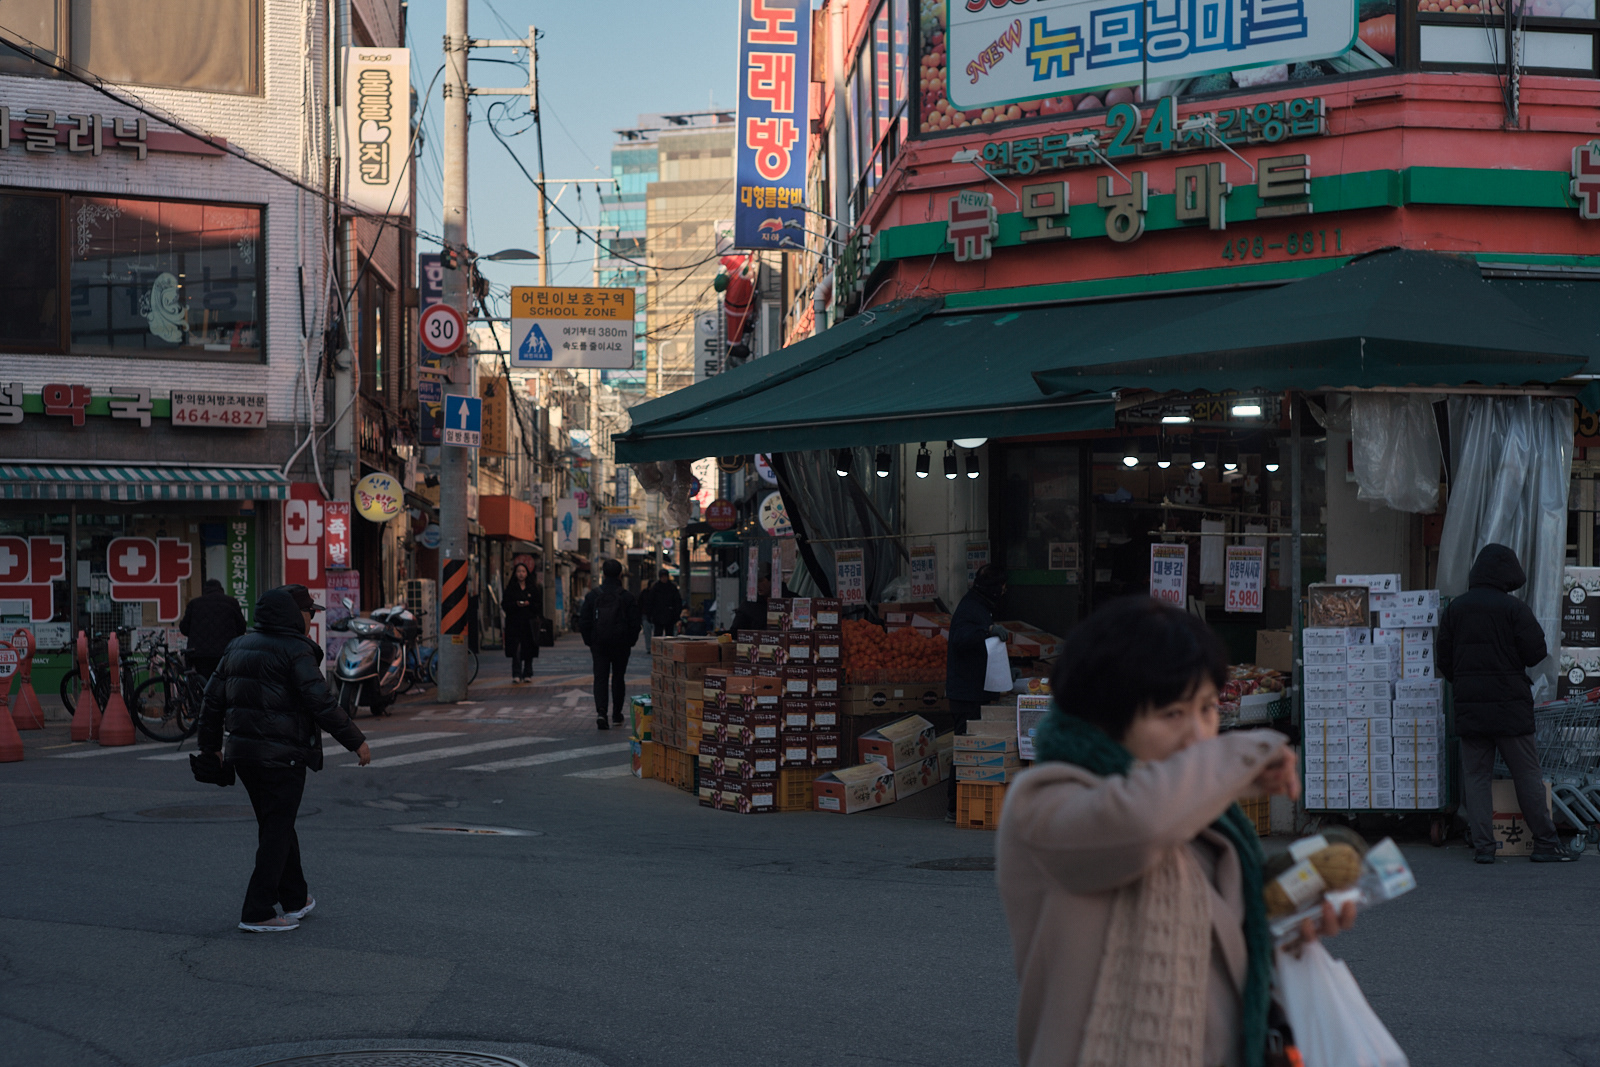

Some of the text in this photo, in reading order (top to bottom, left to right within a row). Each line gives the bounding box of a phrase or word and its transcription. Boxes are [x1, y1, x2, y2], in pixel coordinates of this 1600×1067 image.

[965, 19, 1022, 84] NEW
[747, 0, 800, 181] 노래방
[360, 142, 390, 185] 치킨
[741, 187, 802, 209] 대형룸완비
[961, 193, 985, 207] NEW
[761, 233, 779, 242] 지하
[1222, 229, 1344, 261] 498-8811
[521, 291, 625, 306] 어린이보호구역
[529, 306, 617, 316] SCHOOL ZONE
[431, 319, 454, 339] 30
[562, 327, 628, 337] 여기부터 380m
[562, 342, 623, 351] 속도를 줄이시오
[174, 393, 266, 407] 병·의원처방조제전문
[175, 408, 265, 425] 464-4827
[446, 430, 479, 444] 일방통행
[367, 477, 391, 491] 신성
[284, 499, 324, 580] 약
[327, 518, 348, 564] 족발
[838, 563, 862, 577] 제주감귤
[1153, 560, 1183, 577] 대봉감
[1229, 561, 1260, 579] 안동부사사과
[106, 536, 192, 623] 약
[839, 588, 862, 602] 6,980
[1229, 589, 1259, 606] 5,980
